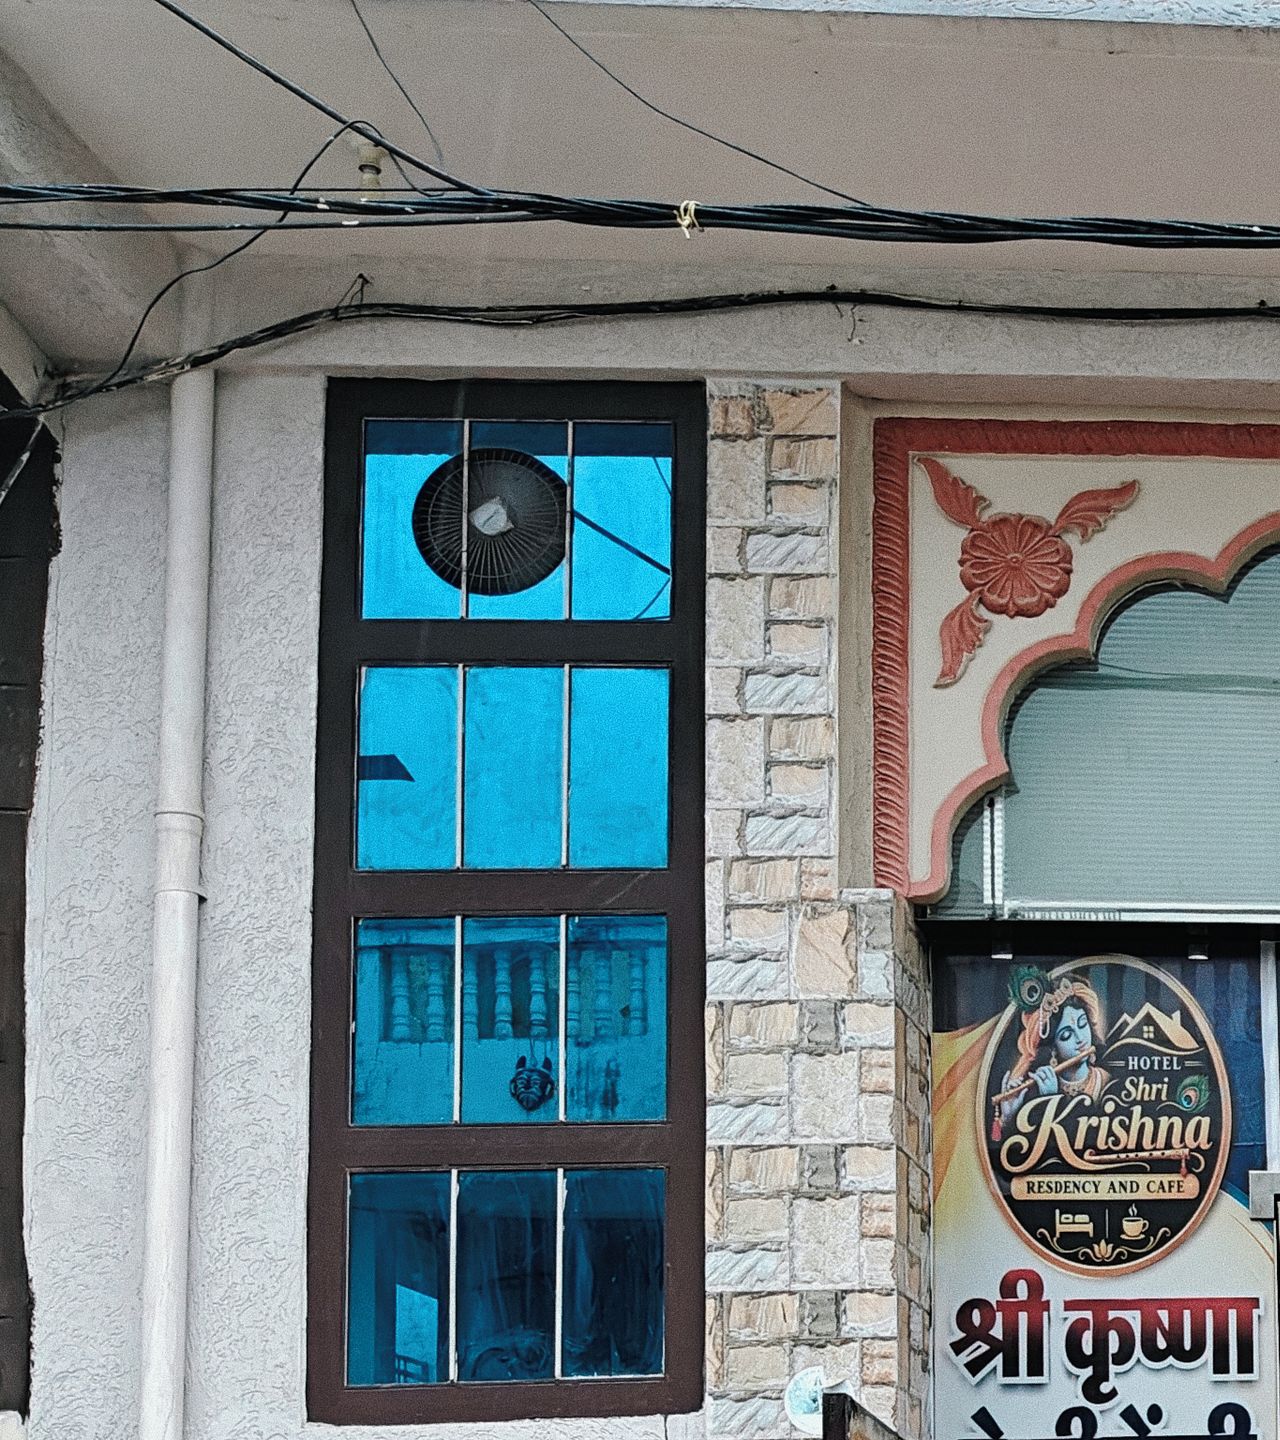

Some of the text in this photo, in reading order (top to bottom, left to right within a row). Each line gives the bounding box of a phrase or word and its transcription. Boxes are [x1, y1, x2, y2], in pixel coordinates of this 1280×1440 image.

[1128, 1056, 1181, 1071] HOTEL
[1121, 1077, 1169, 1102] Shri
[1000, 1094, 1214, 1174] Krishna
[1026, 1179, 1185, 1194] RESDENCY AND CAFE
[949, 1269, 1260, 1405] श्री कृष्णा
